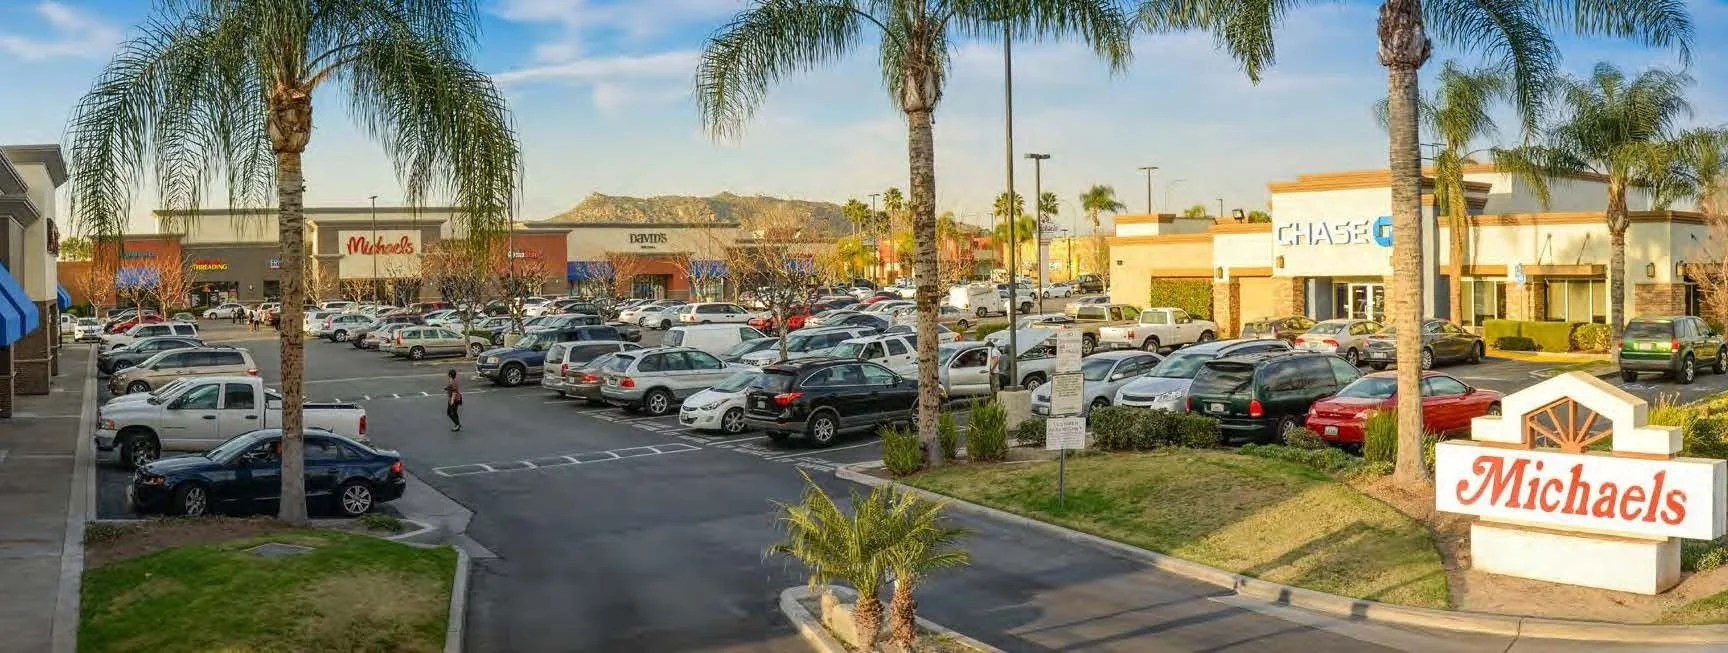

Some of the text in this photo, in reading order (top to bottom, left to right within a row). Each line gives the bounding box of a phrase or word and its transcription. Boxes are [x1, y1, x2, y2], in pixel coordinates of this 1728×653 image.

[1277, 219, 1370, 246] CHASE
[346, 235, 415, 256] Michaels
[191, 263, 229, 272] THREADING
[1455, 455, 1688, 526] Michaels
